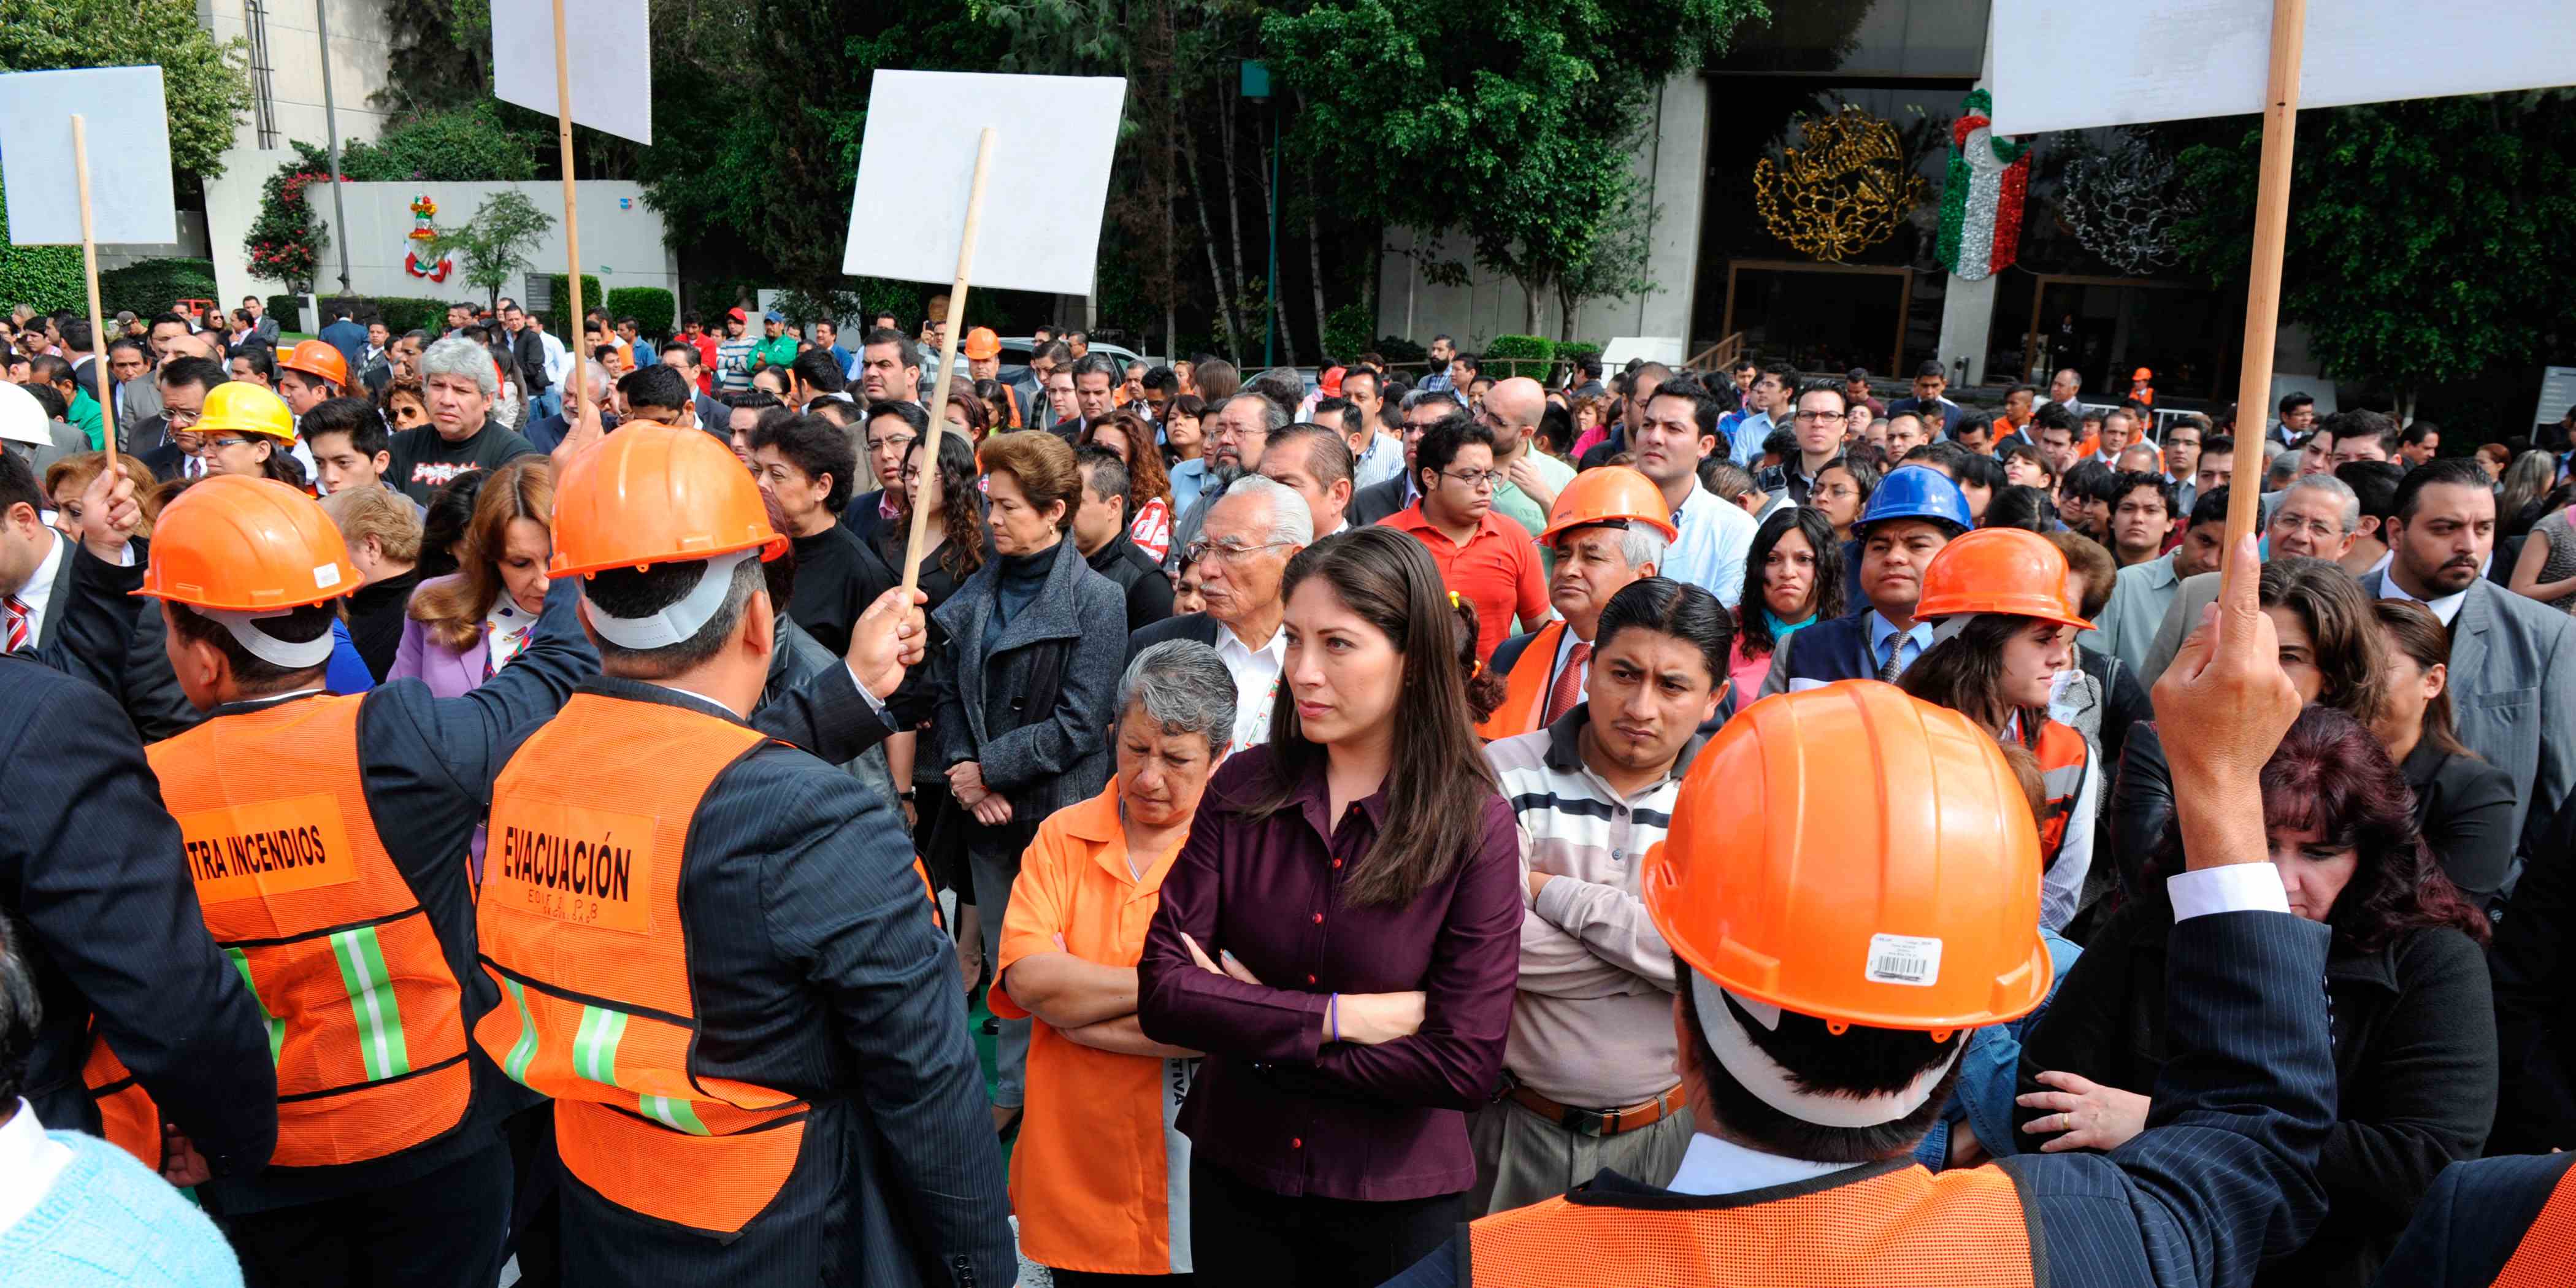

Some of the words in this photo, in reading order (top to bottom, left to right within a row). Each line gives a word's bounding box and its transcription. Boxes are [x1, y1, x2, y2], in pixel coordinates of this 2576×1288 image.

[226, 825, 326, 876] INCENDIOS
[505, 826, 631, 902] EVACUACIÓN
[1171, 1059, 1187, 1106] TIVA
